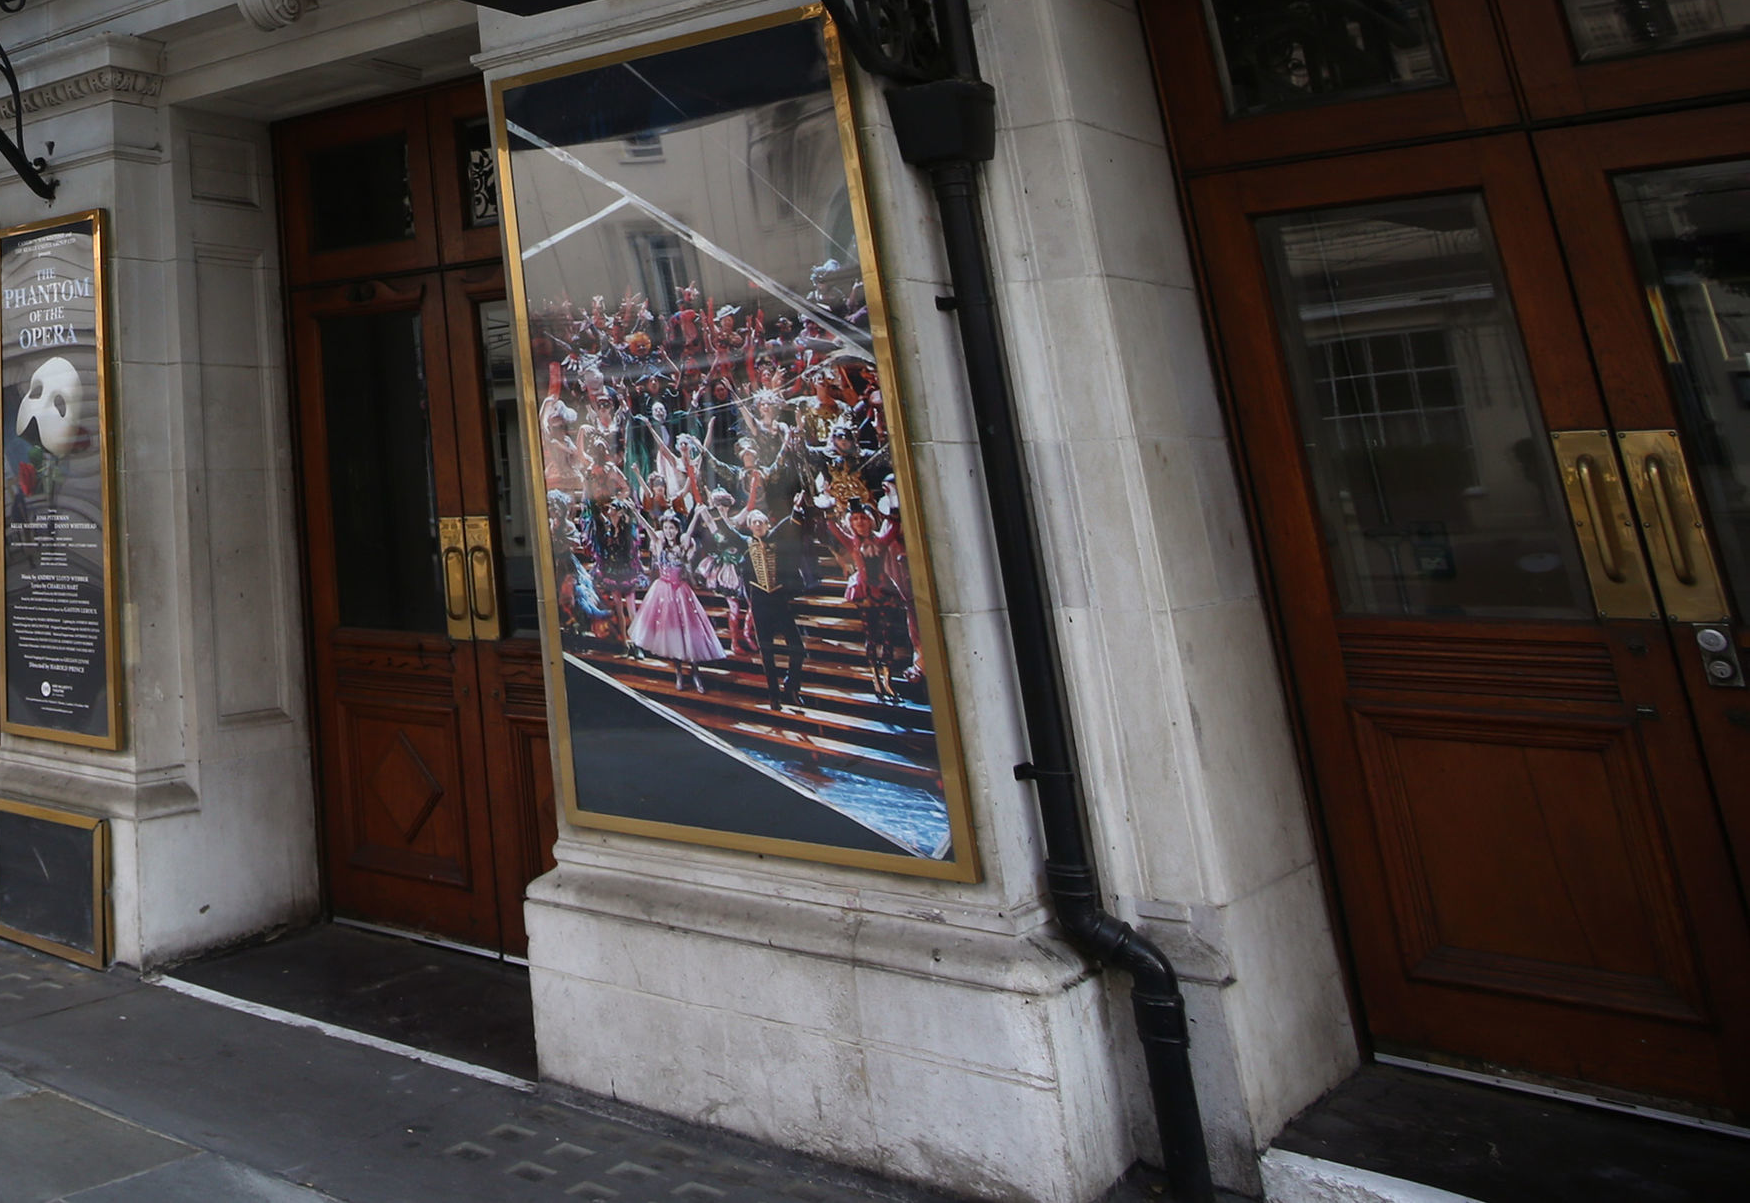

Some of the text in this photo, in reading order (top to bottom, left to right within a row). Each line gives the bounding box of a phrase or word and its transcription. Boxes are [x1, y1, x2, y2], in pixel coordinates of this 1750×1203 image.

[36, 267, 56, 281] THE
[4, 277, 91, 309] PHANTOM
[29, 306, 65, 323] OF THE
[19, 323, 79, 349] OPERA
